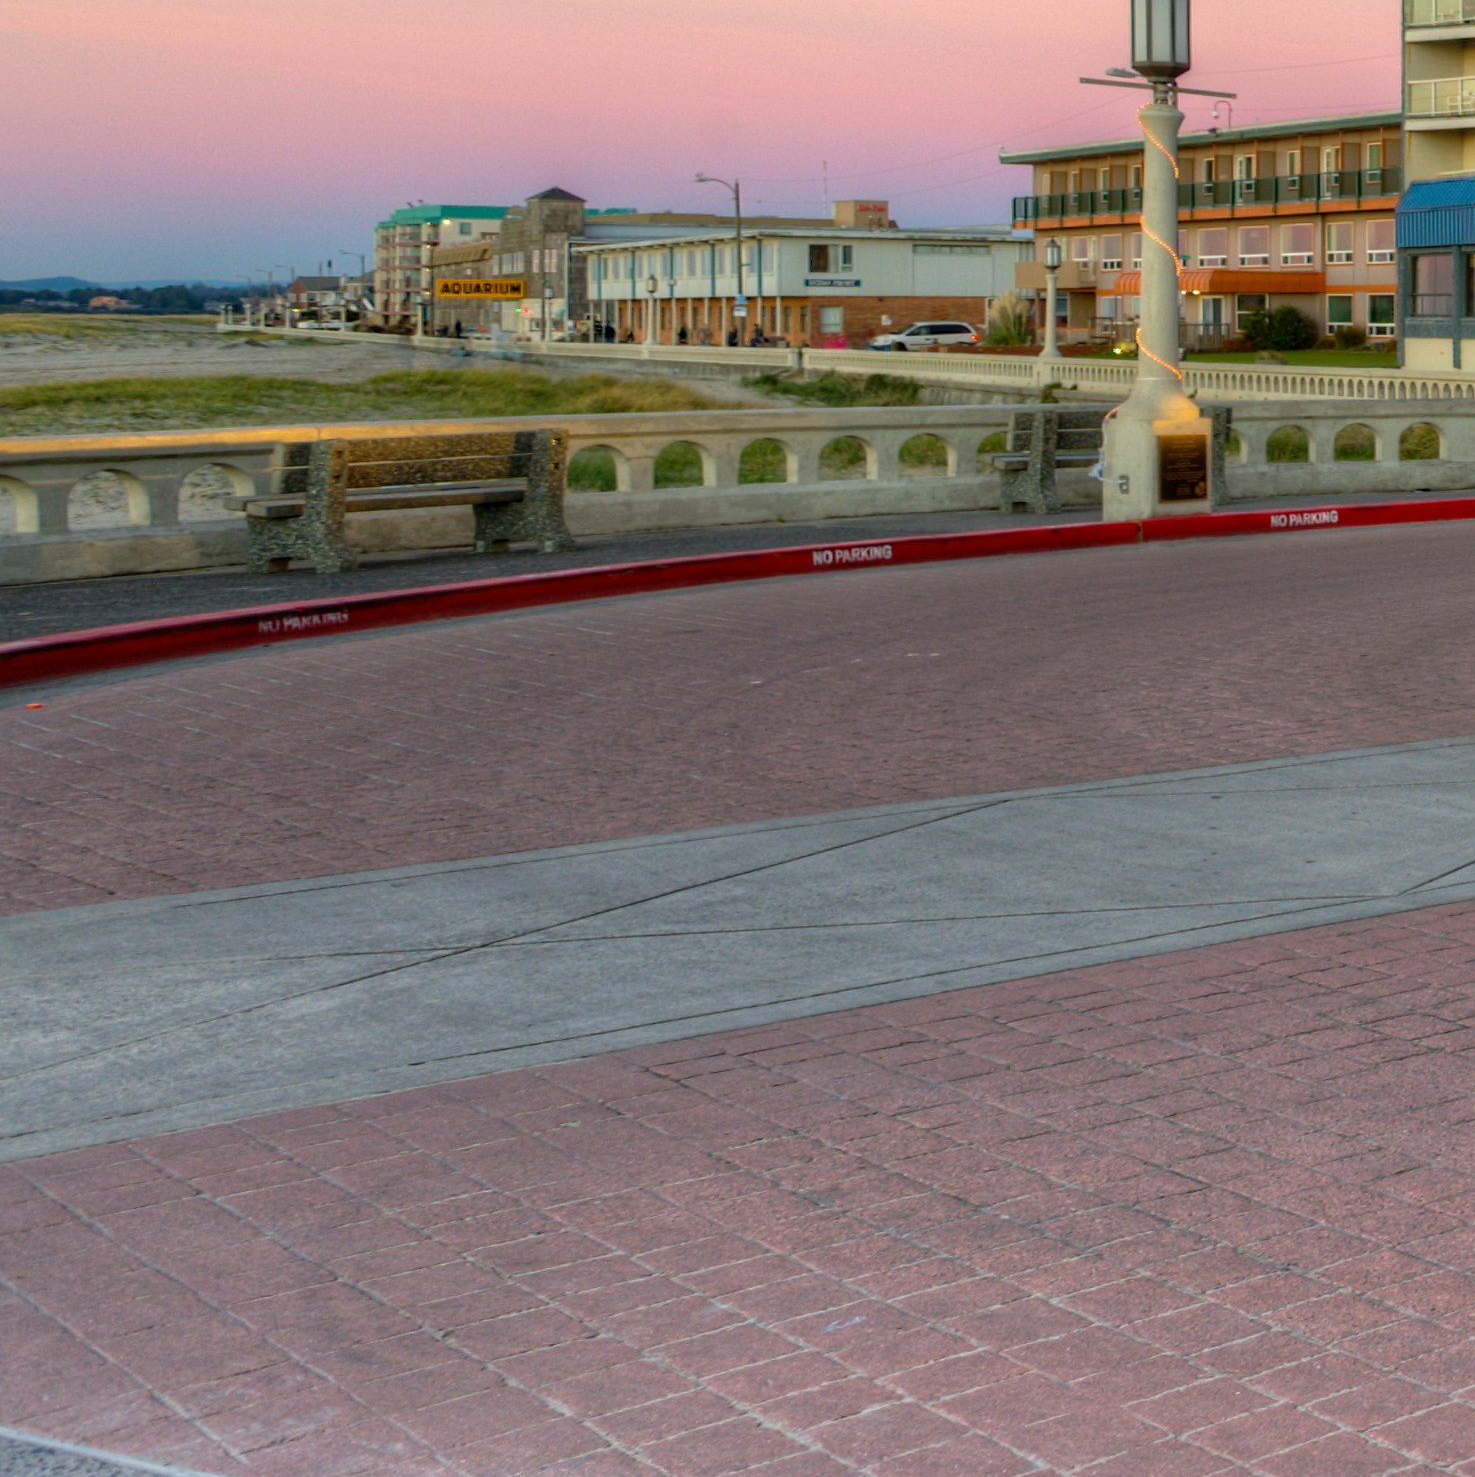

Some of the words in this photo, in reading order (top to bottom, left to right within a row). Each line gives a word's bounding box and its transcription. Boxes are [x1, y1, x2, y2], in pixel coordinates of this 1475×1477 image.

[441, 283, 521, 294] AQUARIUM
[1270, 514, 1287, 528] NO
[1289, 509, 1339, 527] PARKING
[812, 549, 833, 566] NO
[834, 544, 893, 564] PARKING
